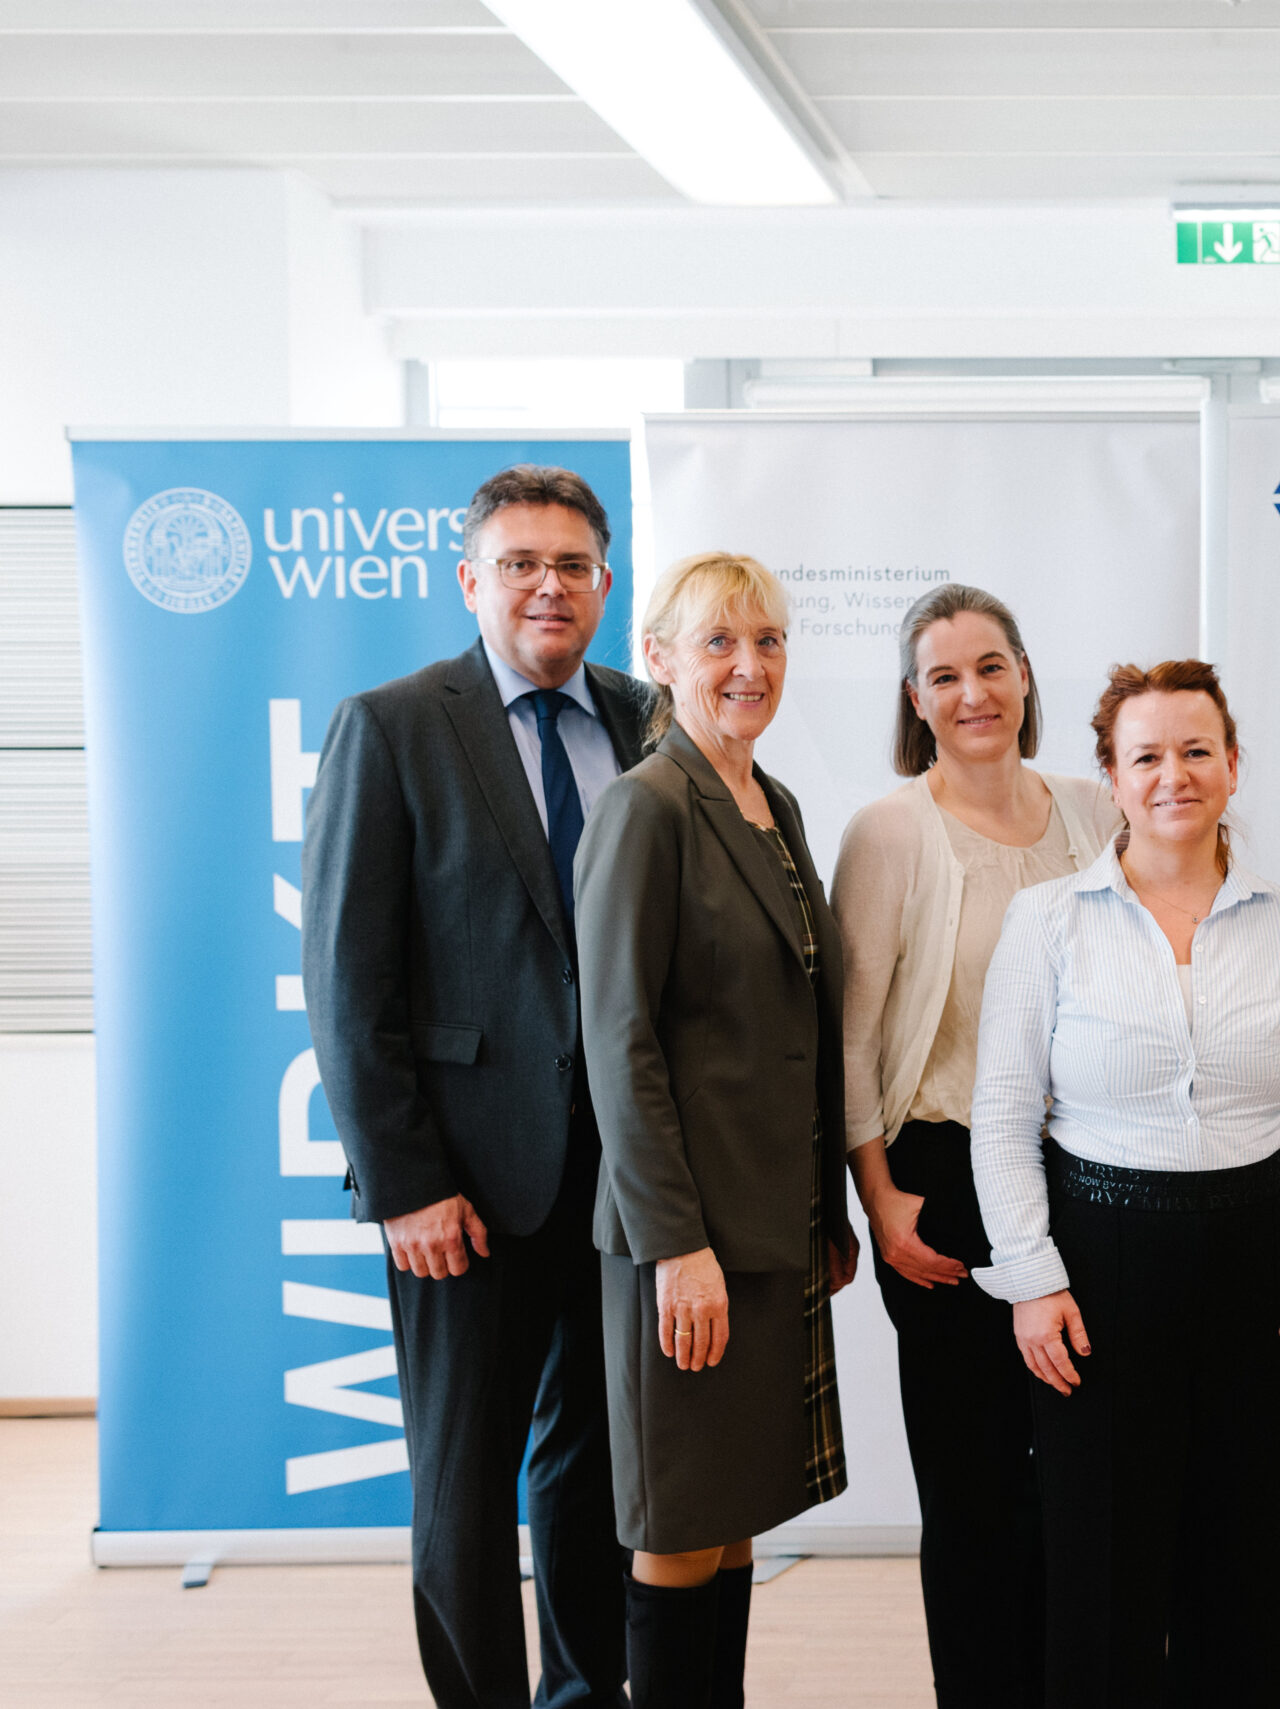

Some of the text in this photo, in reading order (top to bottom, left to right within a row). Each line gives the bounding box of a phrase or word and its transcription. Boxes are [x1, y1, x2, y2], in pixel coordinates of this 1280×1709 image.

[264, 492, 469, 552] univers
[267, 554, 429, 599] wien
[775, 564, 951, 582] ndesministerium
[843, 591, 916, 609] Wissen
